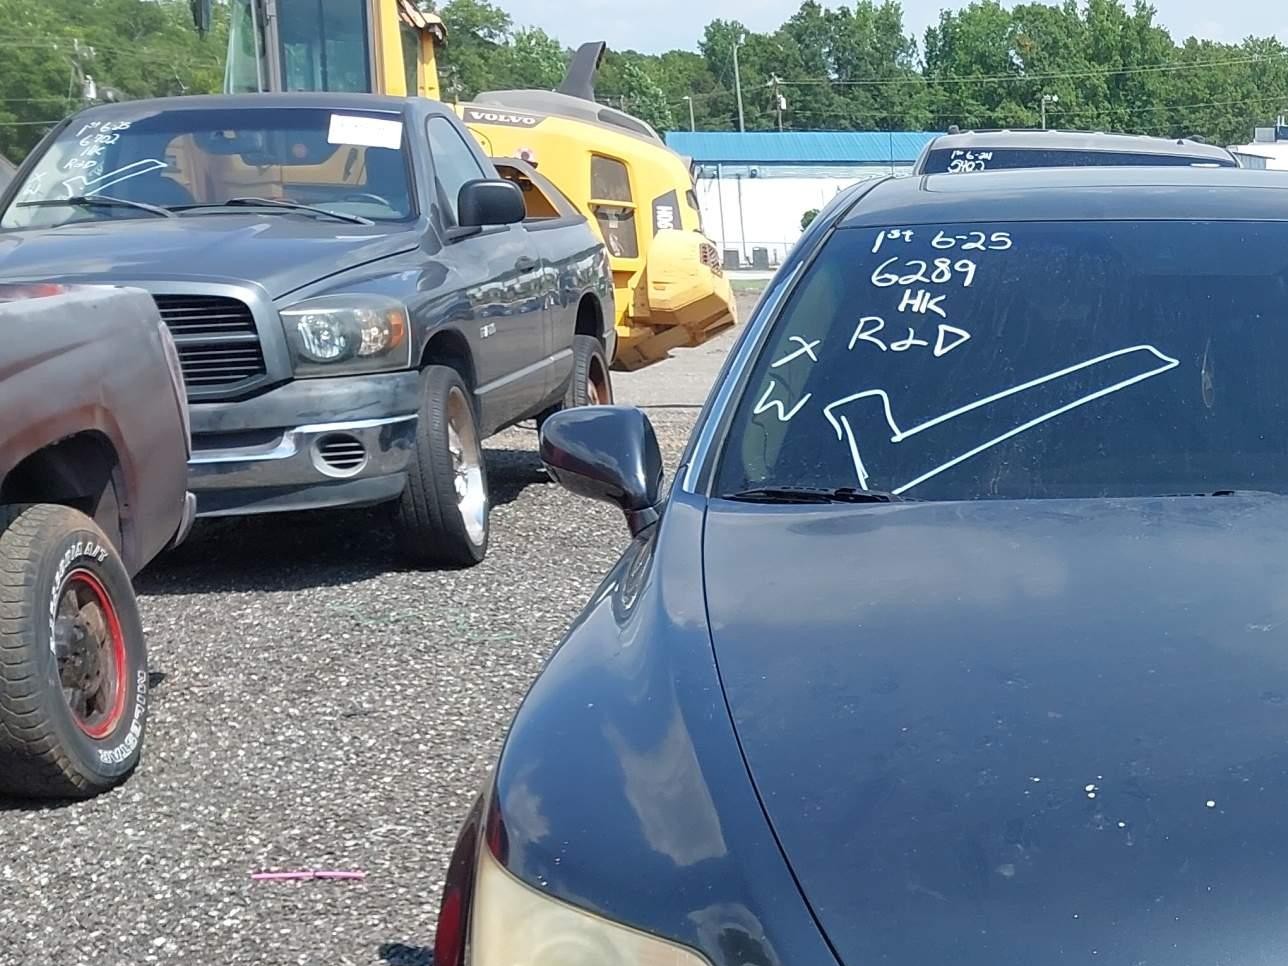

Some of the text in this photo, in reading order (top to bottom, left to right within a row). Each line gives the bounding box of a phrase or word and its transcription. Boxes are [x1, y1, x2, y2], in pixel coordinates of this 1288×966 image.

[469, 110, 536, 125] VOLVO
[871, 229, 1012, 253] 1st 6-25
[871, 256, 977, 287] 6289
[898, 288, 947, 318] HK
[771, 335, 821, 368] X
